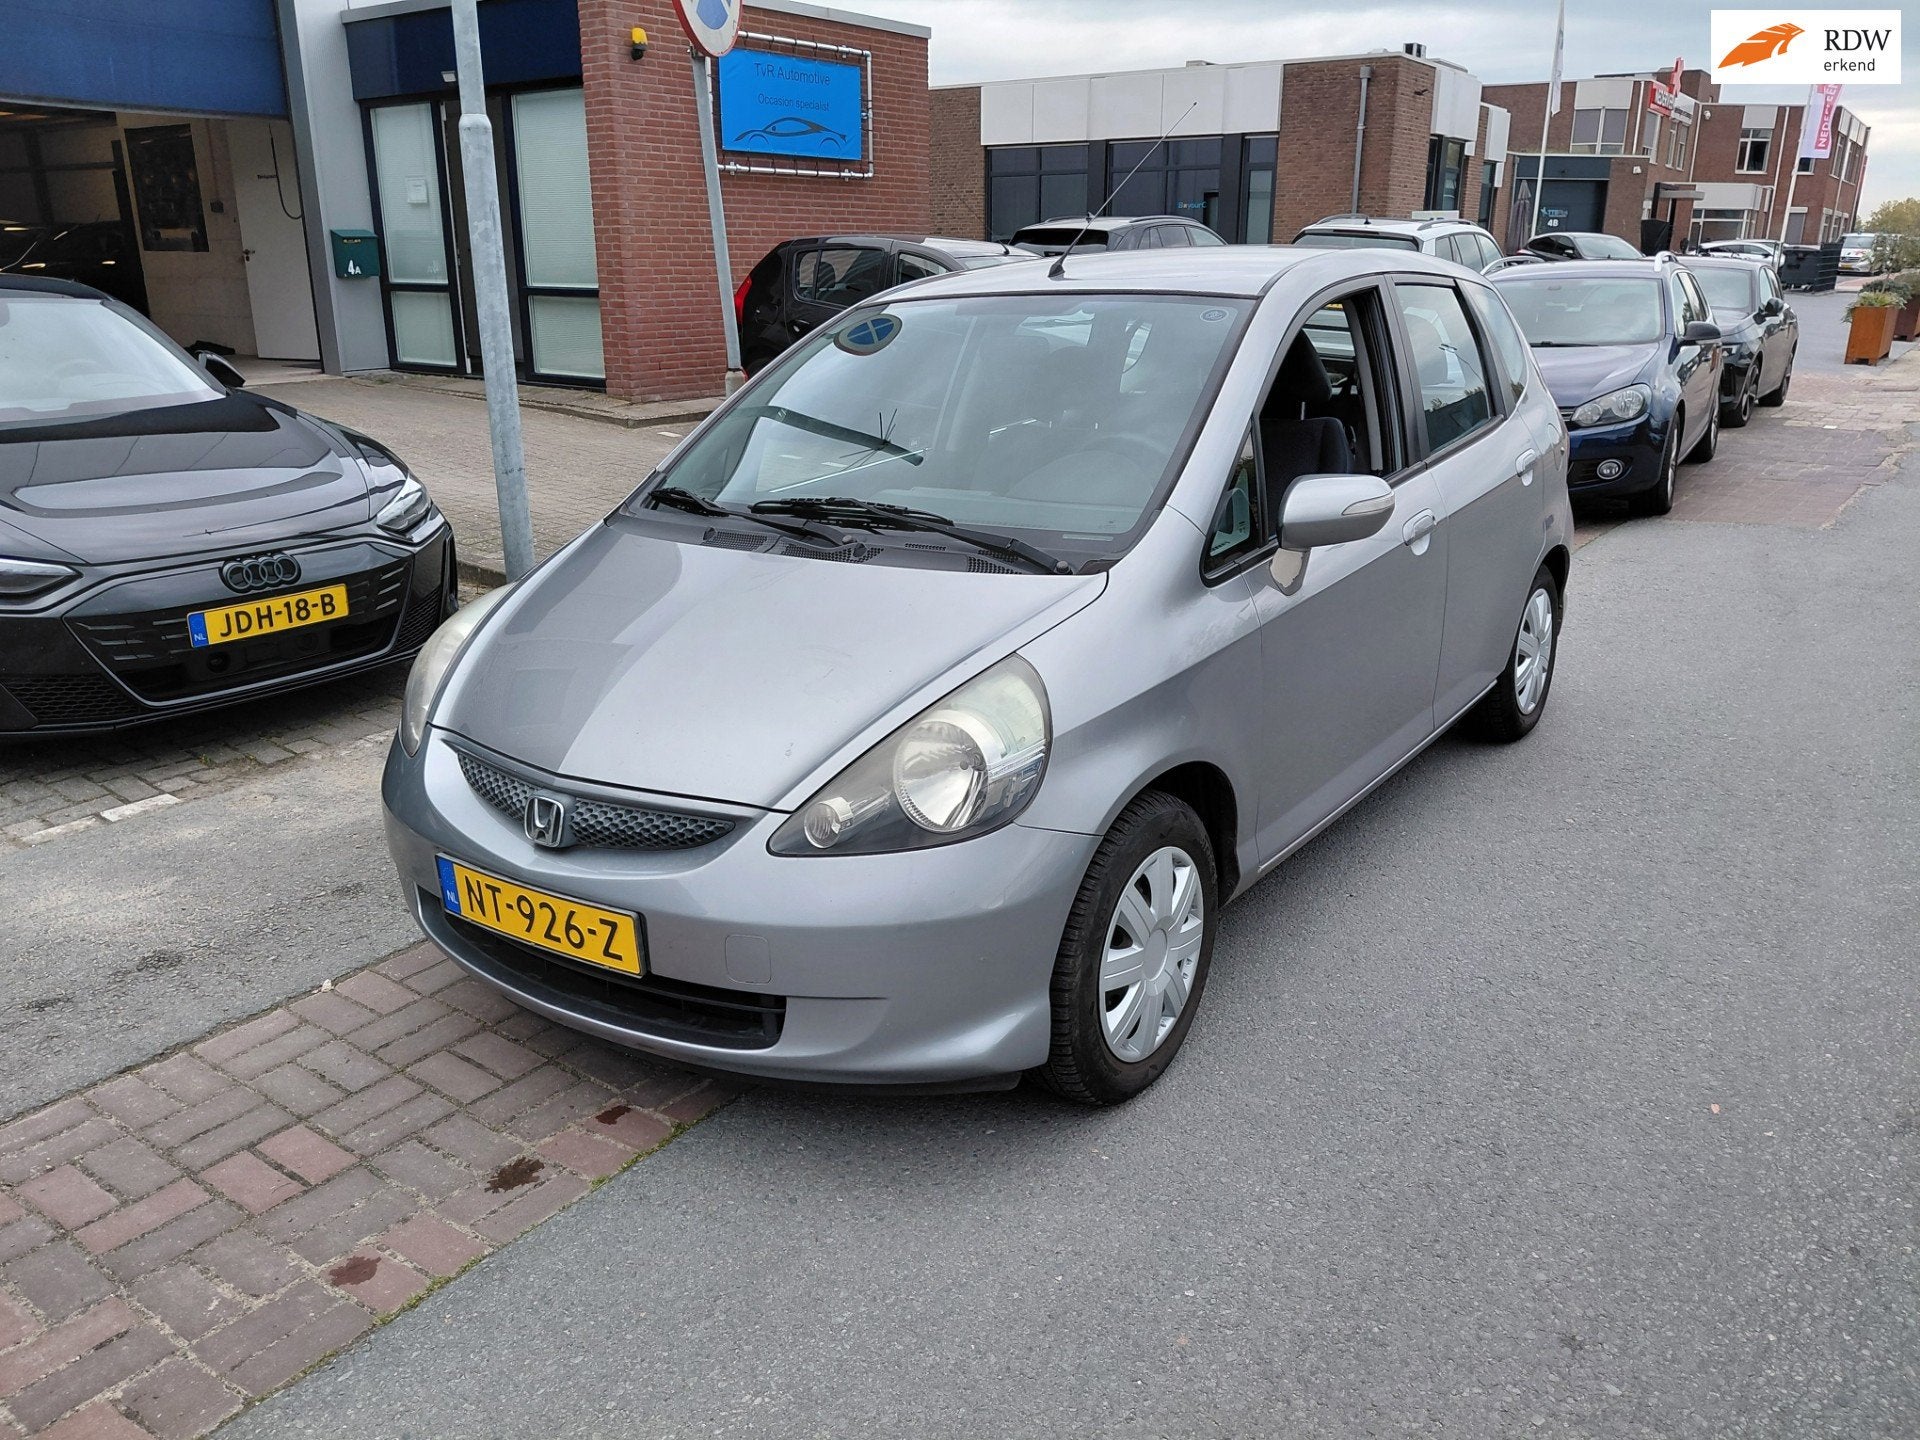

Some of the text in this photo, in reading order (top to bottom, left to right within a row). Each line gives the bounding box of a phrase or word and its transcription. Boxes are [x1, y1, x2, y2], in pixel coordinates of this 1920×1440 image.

[777, 66, 830, 86] Automotive
[758, 93, 829, 112] Occasion specialist
[1547, 219, 1559, 227] 4B
[347, 260, 362, 275] 4A
[194, 593, 336, 642] NL JDH-18-B
[464, 875, 623, 962] NT-926-Z
